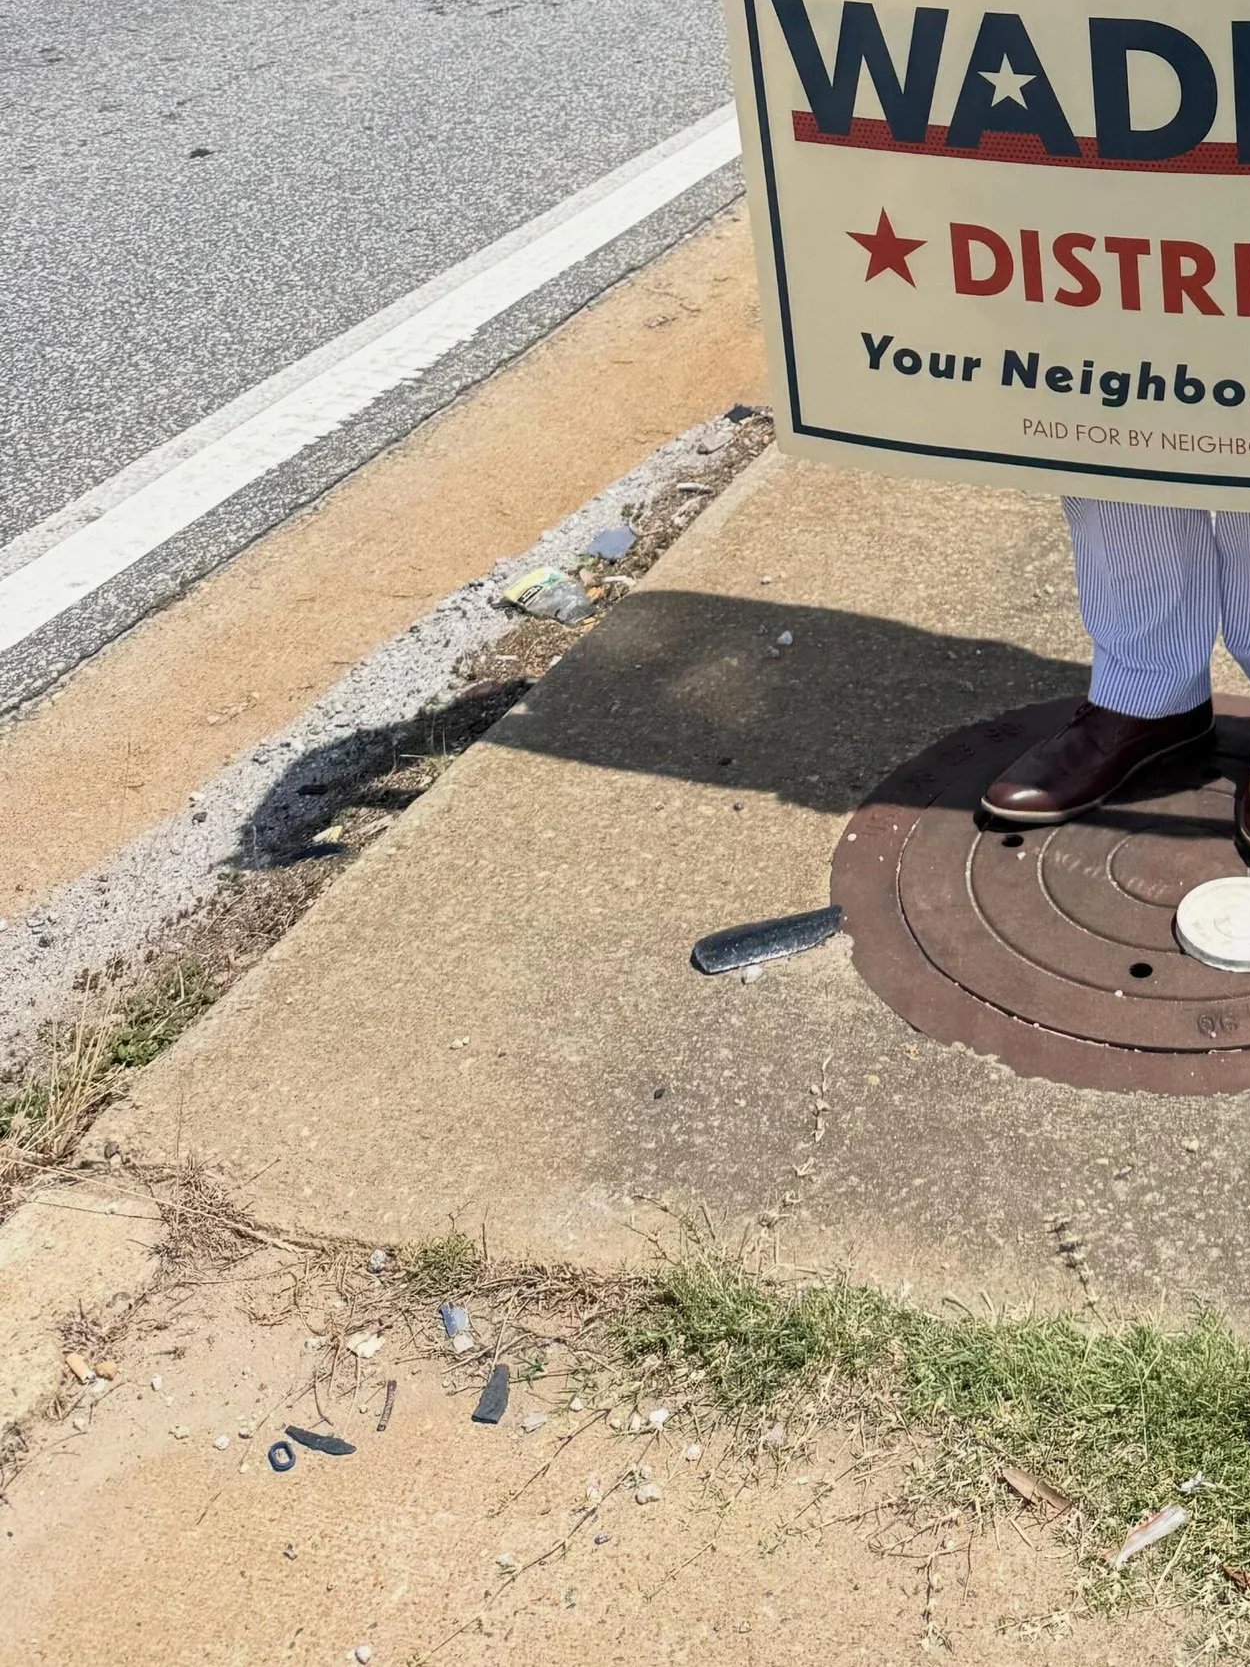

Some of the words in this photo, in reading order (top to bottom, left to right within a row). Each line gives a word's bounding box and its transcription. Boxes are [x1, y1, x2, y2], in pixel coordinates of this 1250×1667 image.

[861, 332, 982, 382] Your
[1023, 418, 1069, 440] PAID
[1076, 424, 1122, 446] FOR
[1129, 430, 1154, 449] BY
